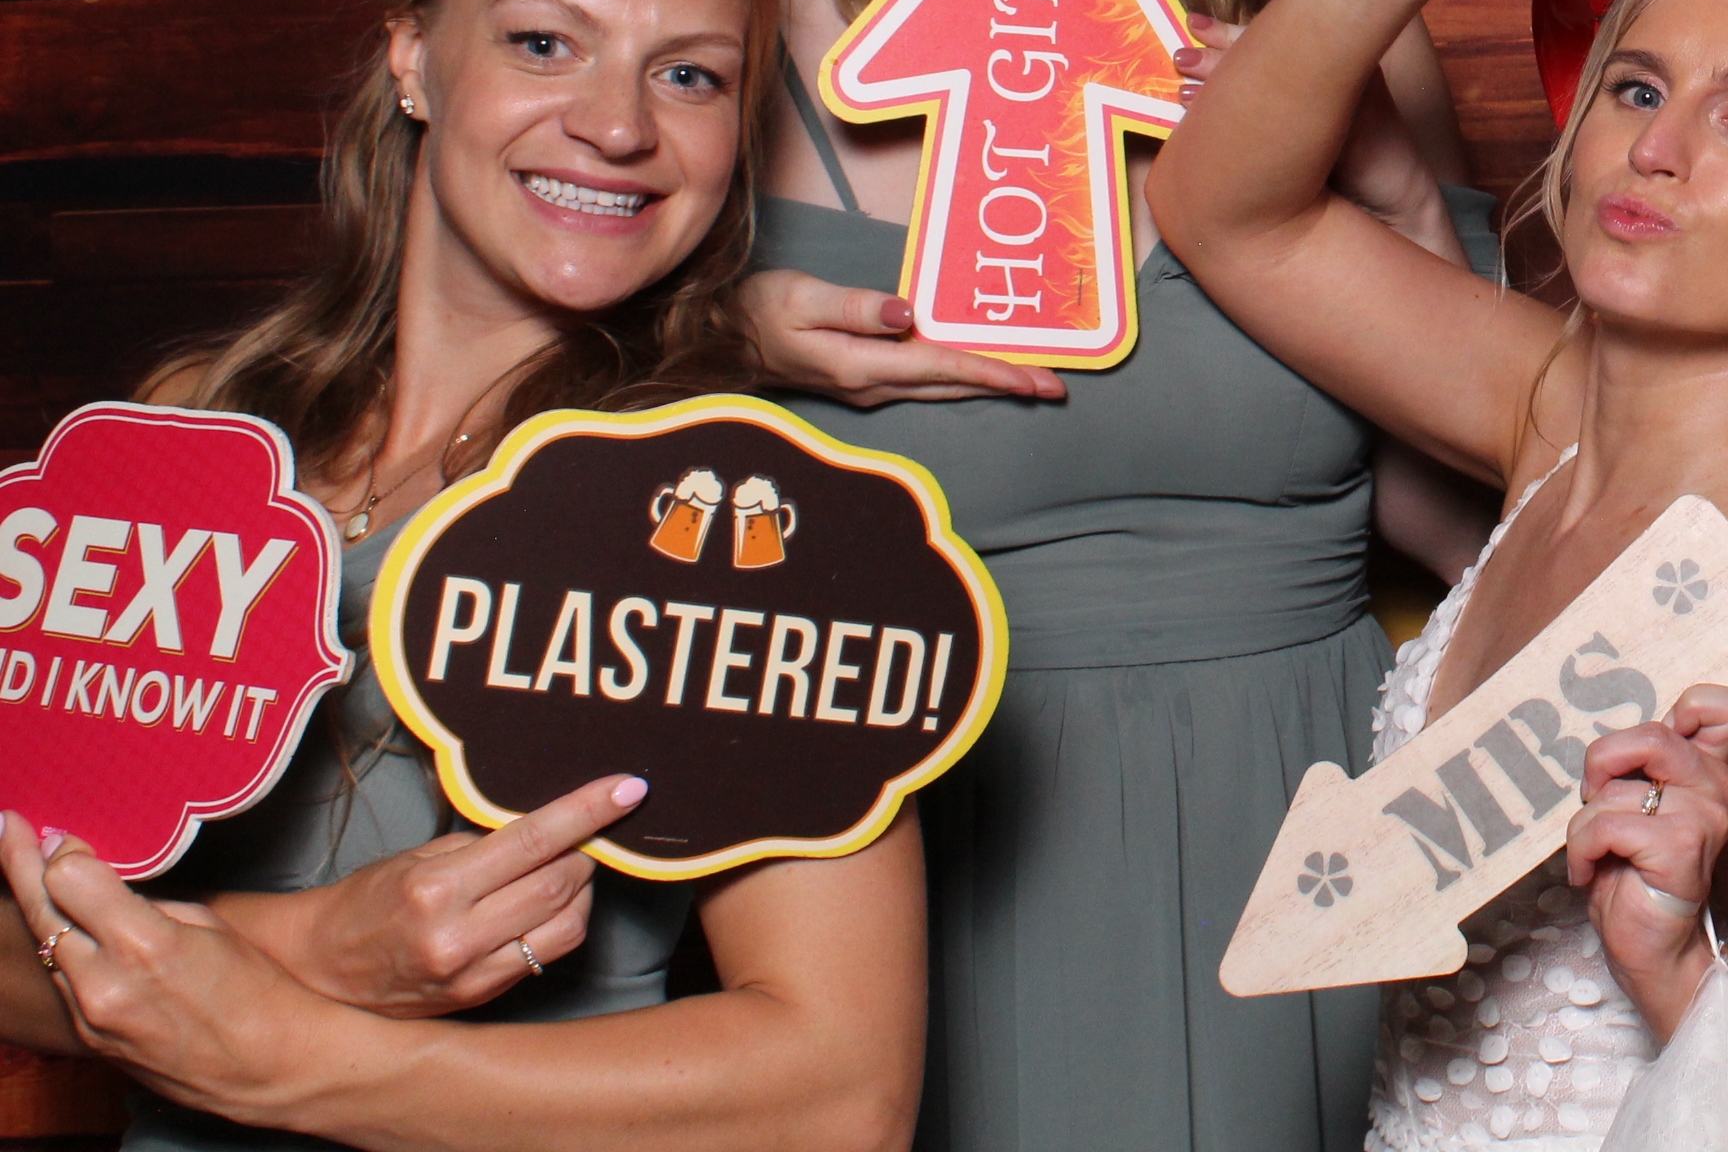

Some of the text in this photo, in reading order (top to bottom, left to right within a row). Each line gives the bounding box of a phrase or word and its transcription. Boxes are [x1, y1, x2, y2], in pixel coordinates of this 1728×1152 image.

[973, 118, 1051, 322] HOT
[0, 507, 299, 663] SEXY
[427, 575, 955, 733] PLASTERED!
[41, 656, 63, 709] I
[64, 660, 225, 733] KNOW
[224, 685, 279, 743] IT
[1382, 630, 1658, 892] MRS
